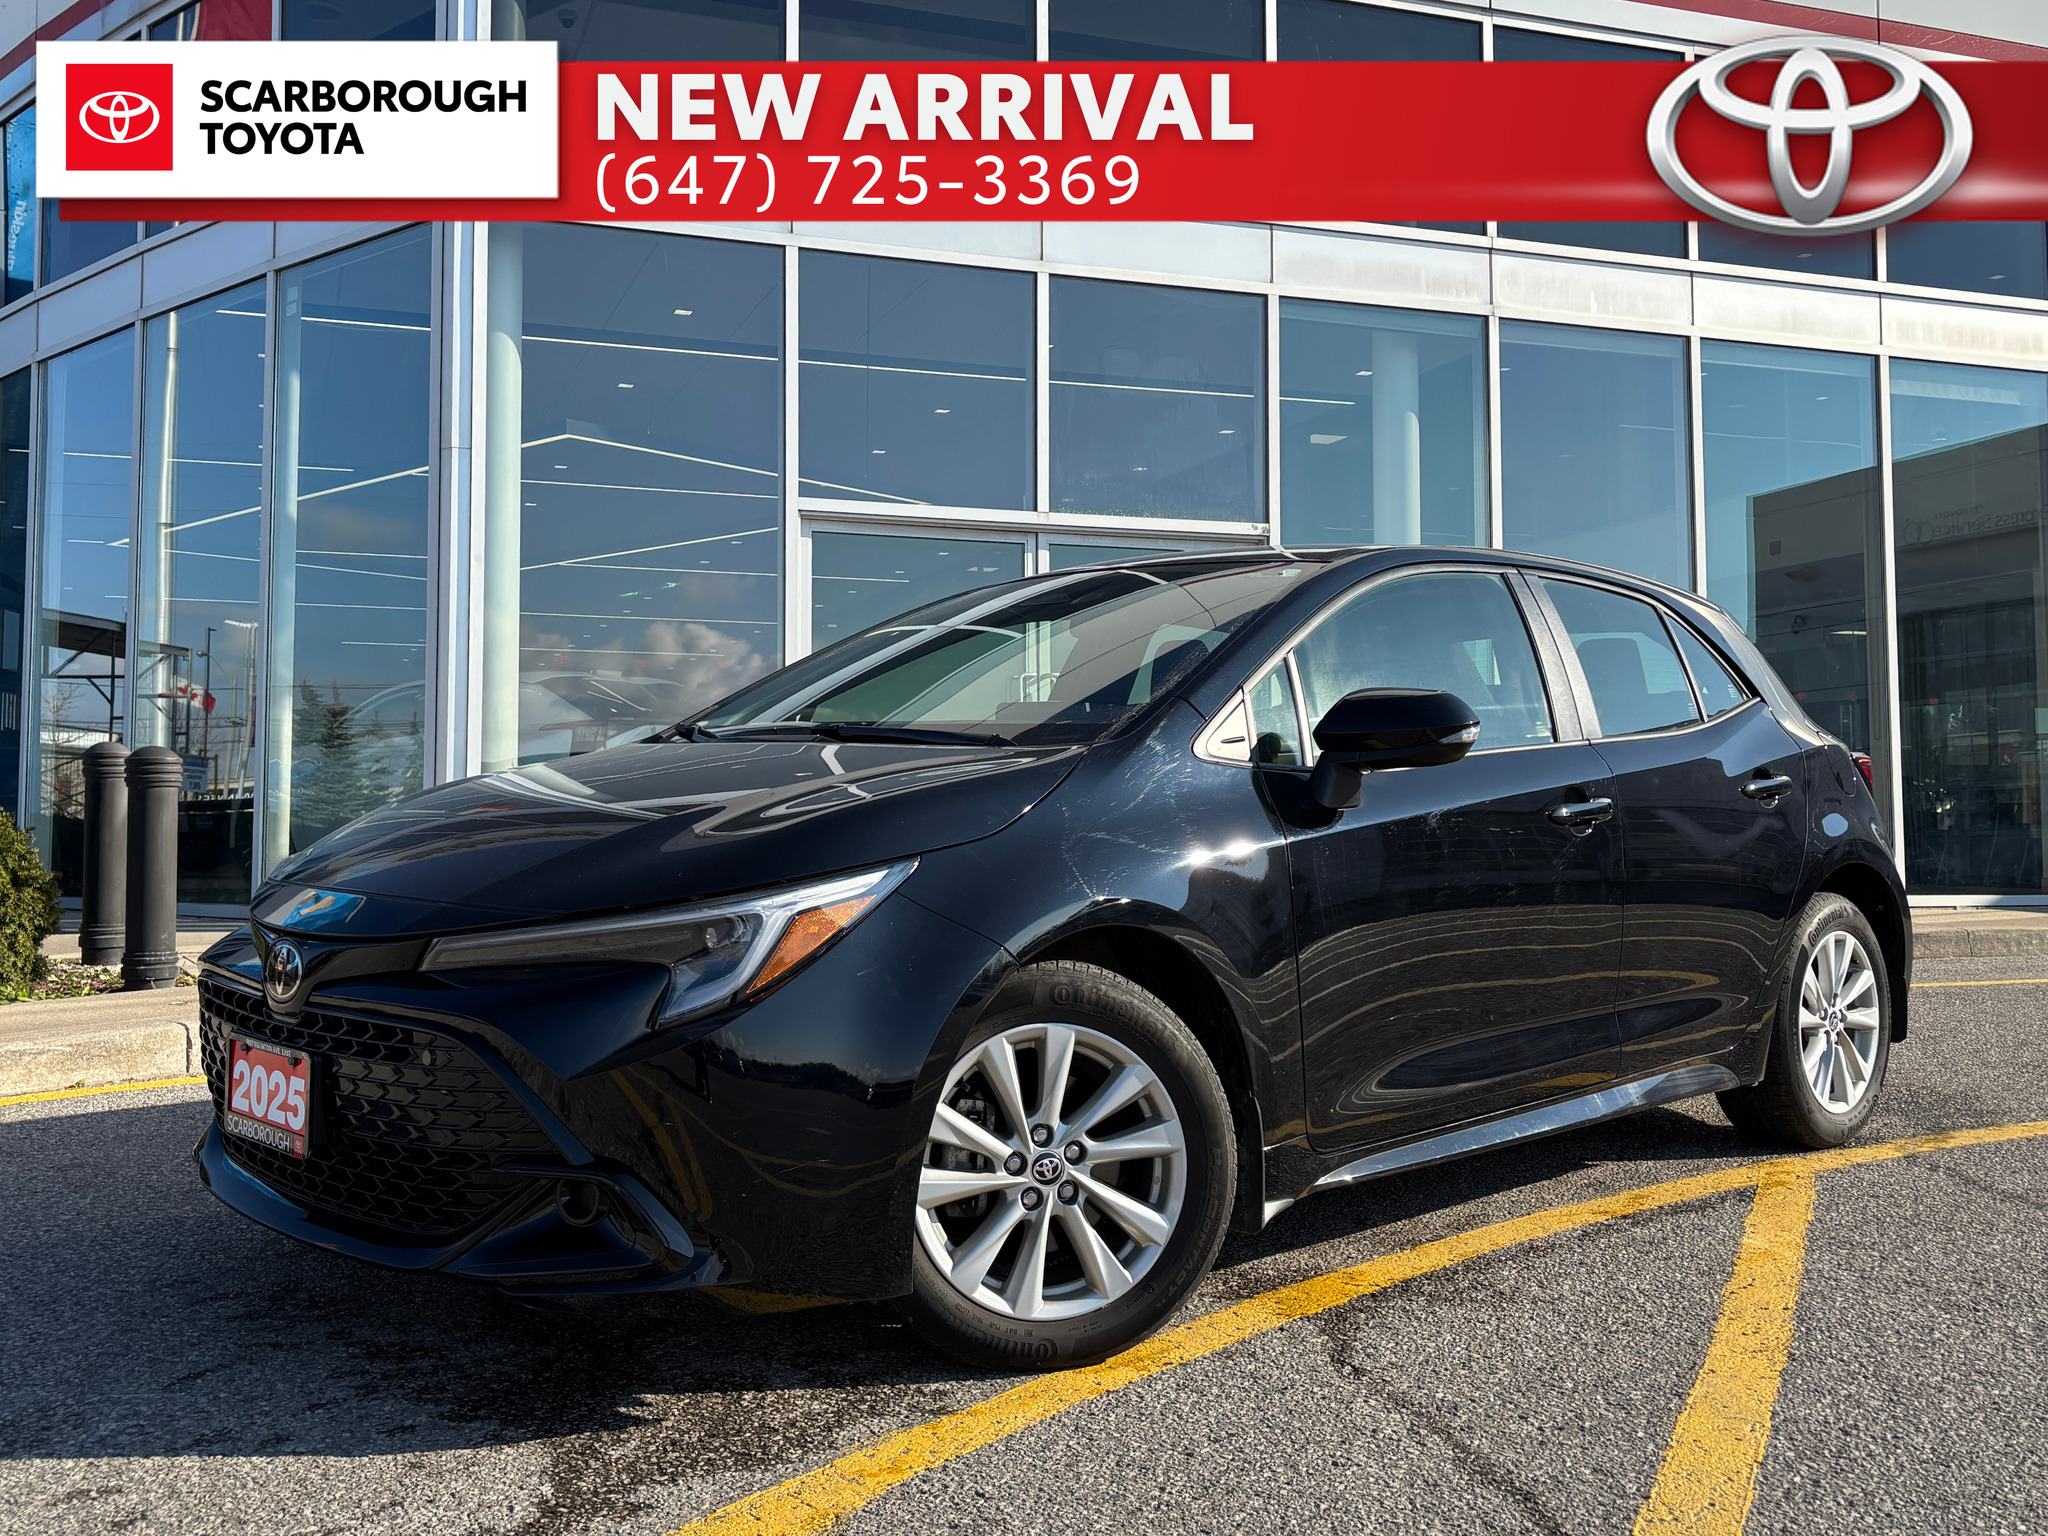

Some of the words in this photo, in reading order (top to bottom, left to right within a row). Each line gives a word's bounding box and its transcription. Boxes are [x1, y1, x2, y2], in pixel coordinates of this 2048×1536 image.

[1808, 905, 1845, 948] Continental
[231, 1058, 306, 1131] 2025
[227, 1114, 291, 1153] SCARBOROUGH
